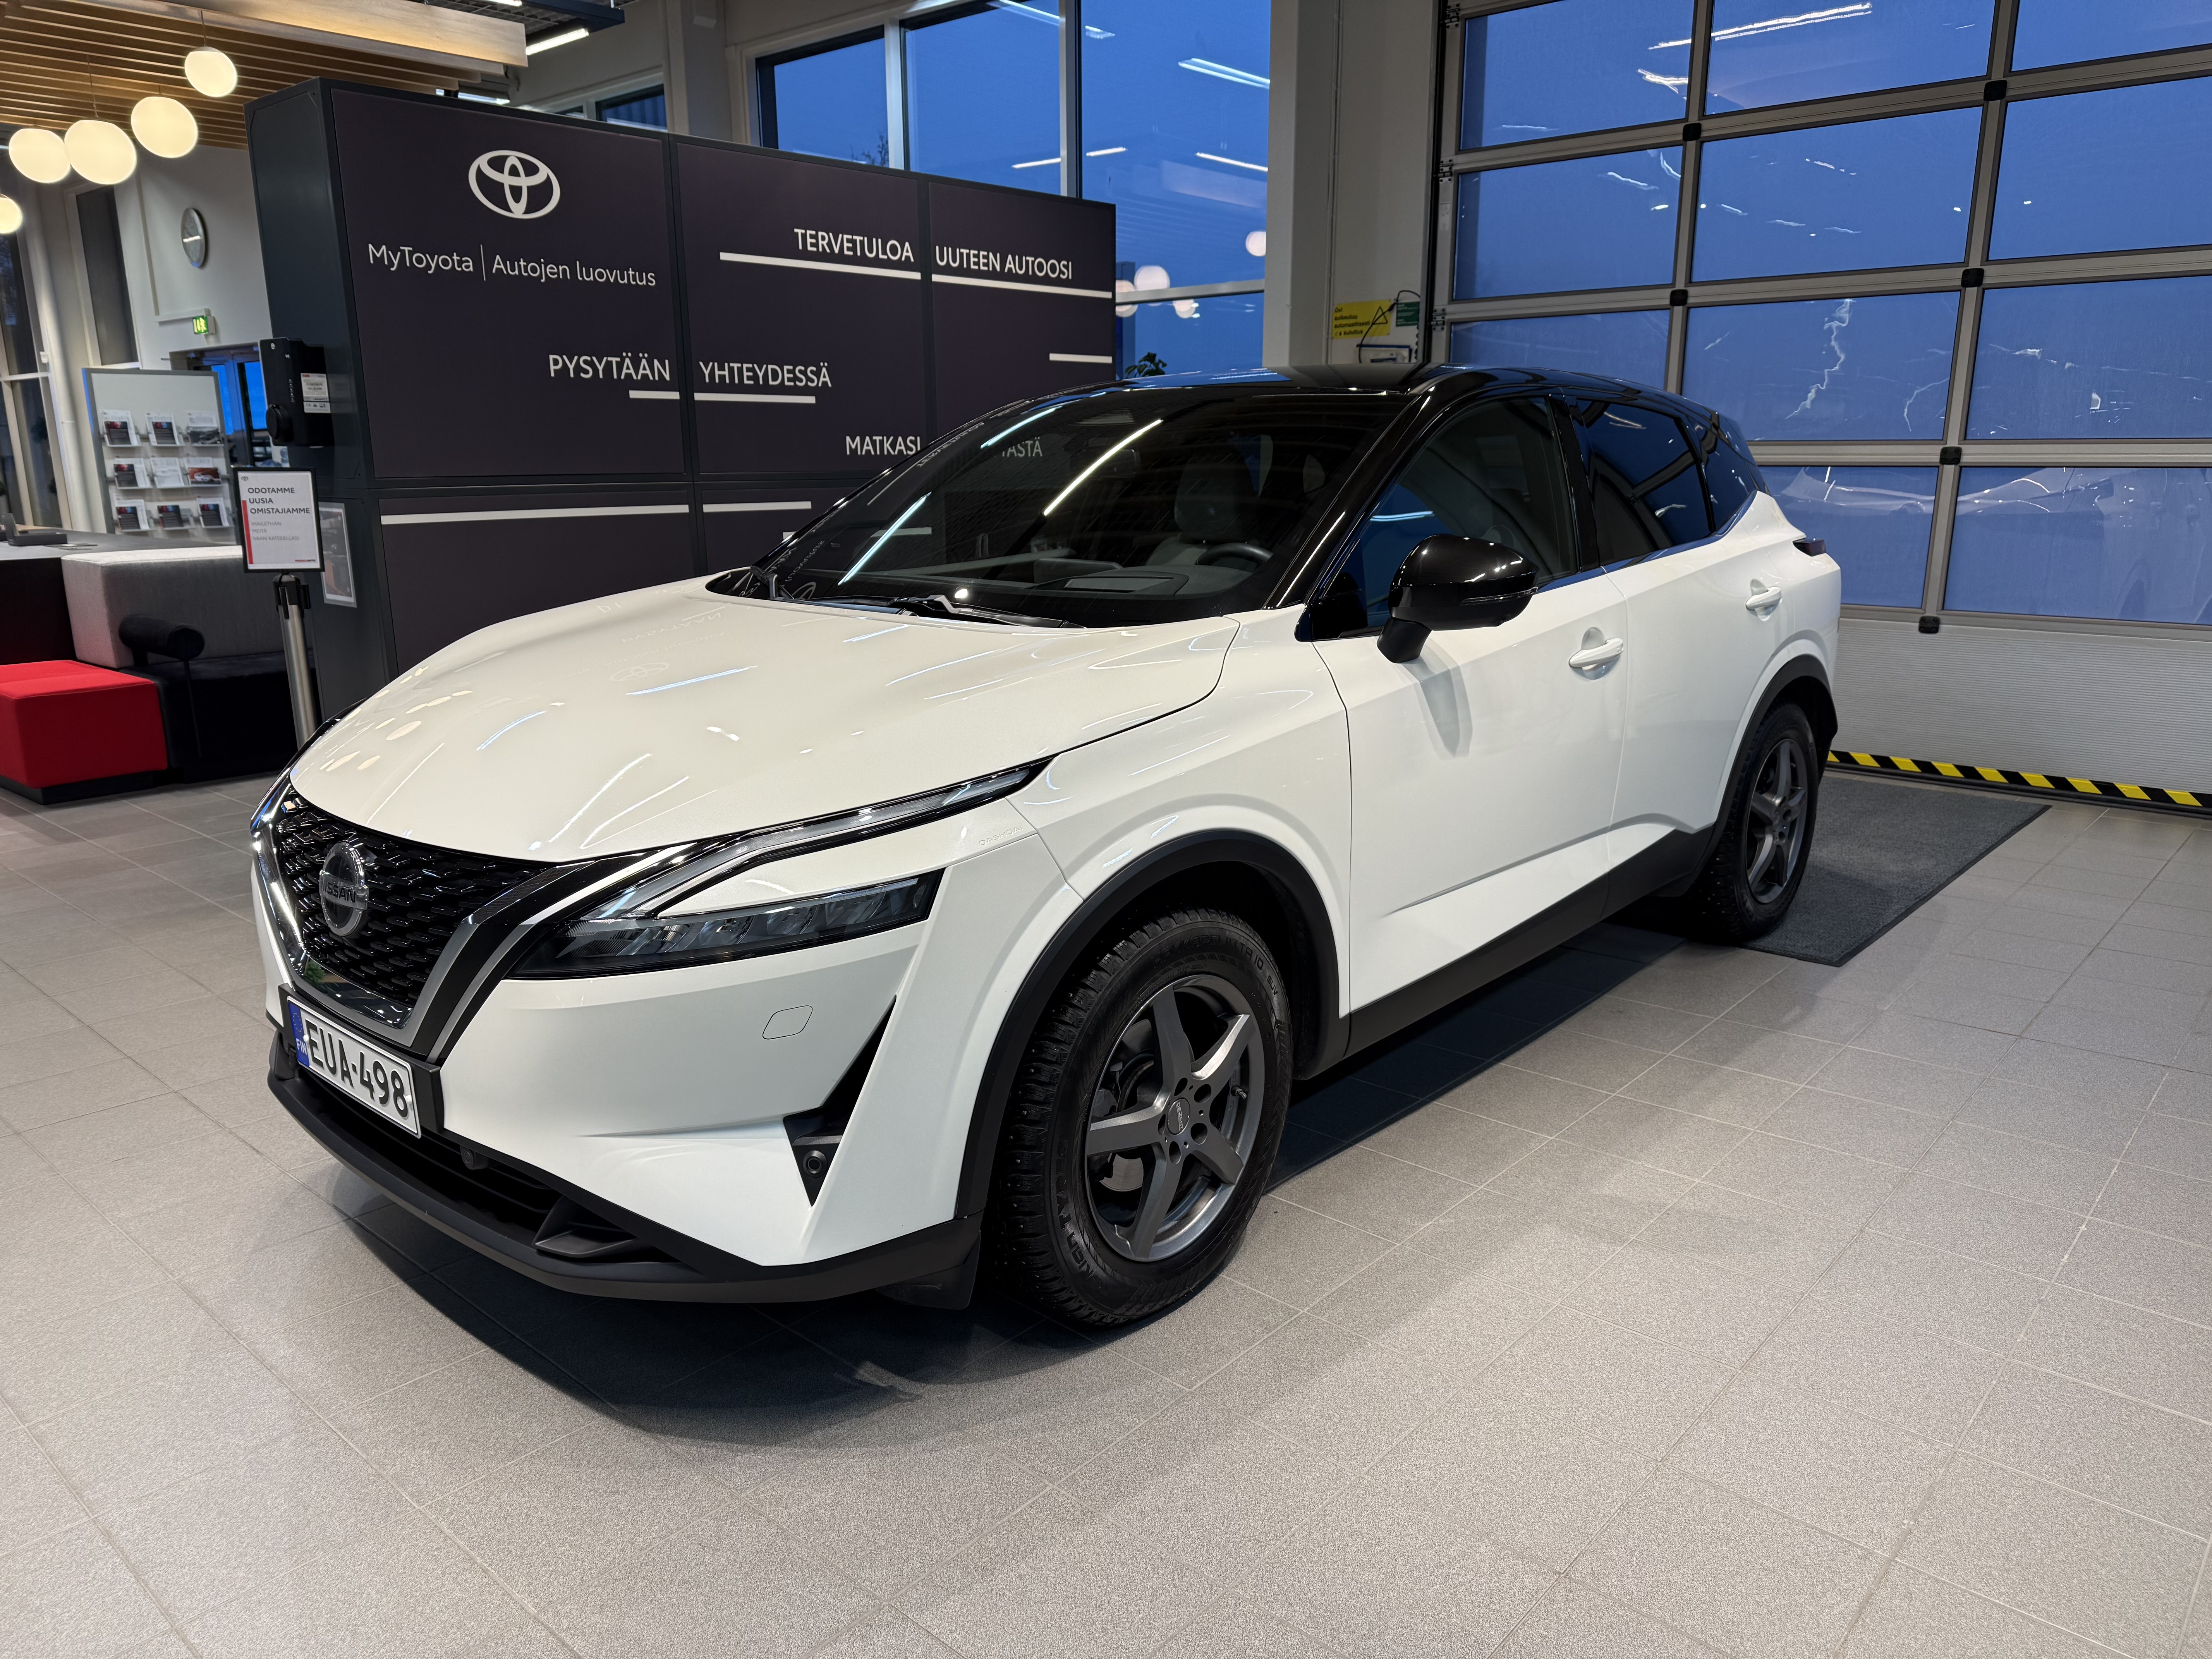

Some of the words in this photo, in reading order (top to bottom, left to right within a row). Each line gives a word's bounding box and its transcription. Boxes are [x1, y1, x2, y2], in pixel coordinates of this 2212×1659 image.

[368, 244, 474, 274] MyToyota
[492, 254, 570, 283] Autojen
[577, 261, 656, 287] luovutus
[794, 228, 914, 263] TERVETULOA
[935, 245, 1000, 273] UUTEEN
[1004, 255, 1072, 280] AUTOOSI
[548, 352, 671, 381] PYSYTÄÄN
[699, 361, 832, 388] YHTEYDESSÄ
[846, 435, 922, 456] MATKASI
[320, 875, 357, 903] NISSAN
[1266, 975, 1278, 996] SUV
[295, 1039, 307, 1056] FIN
[306, 1022, 408, 1118] EUA-498
